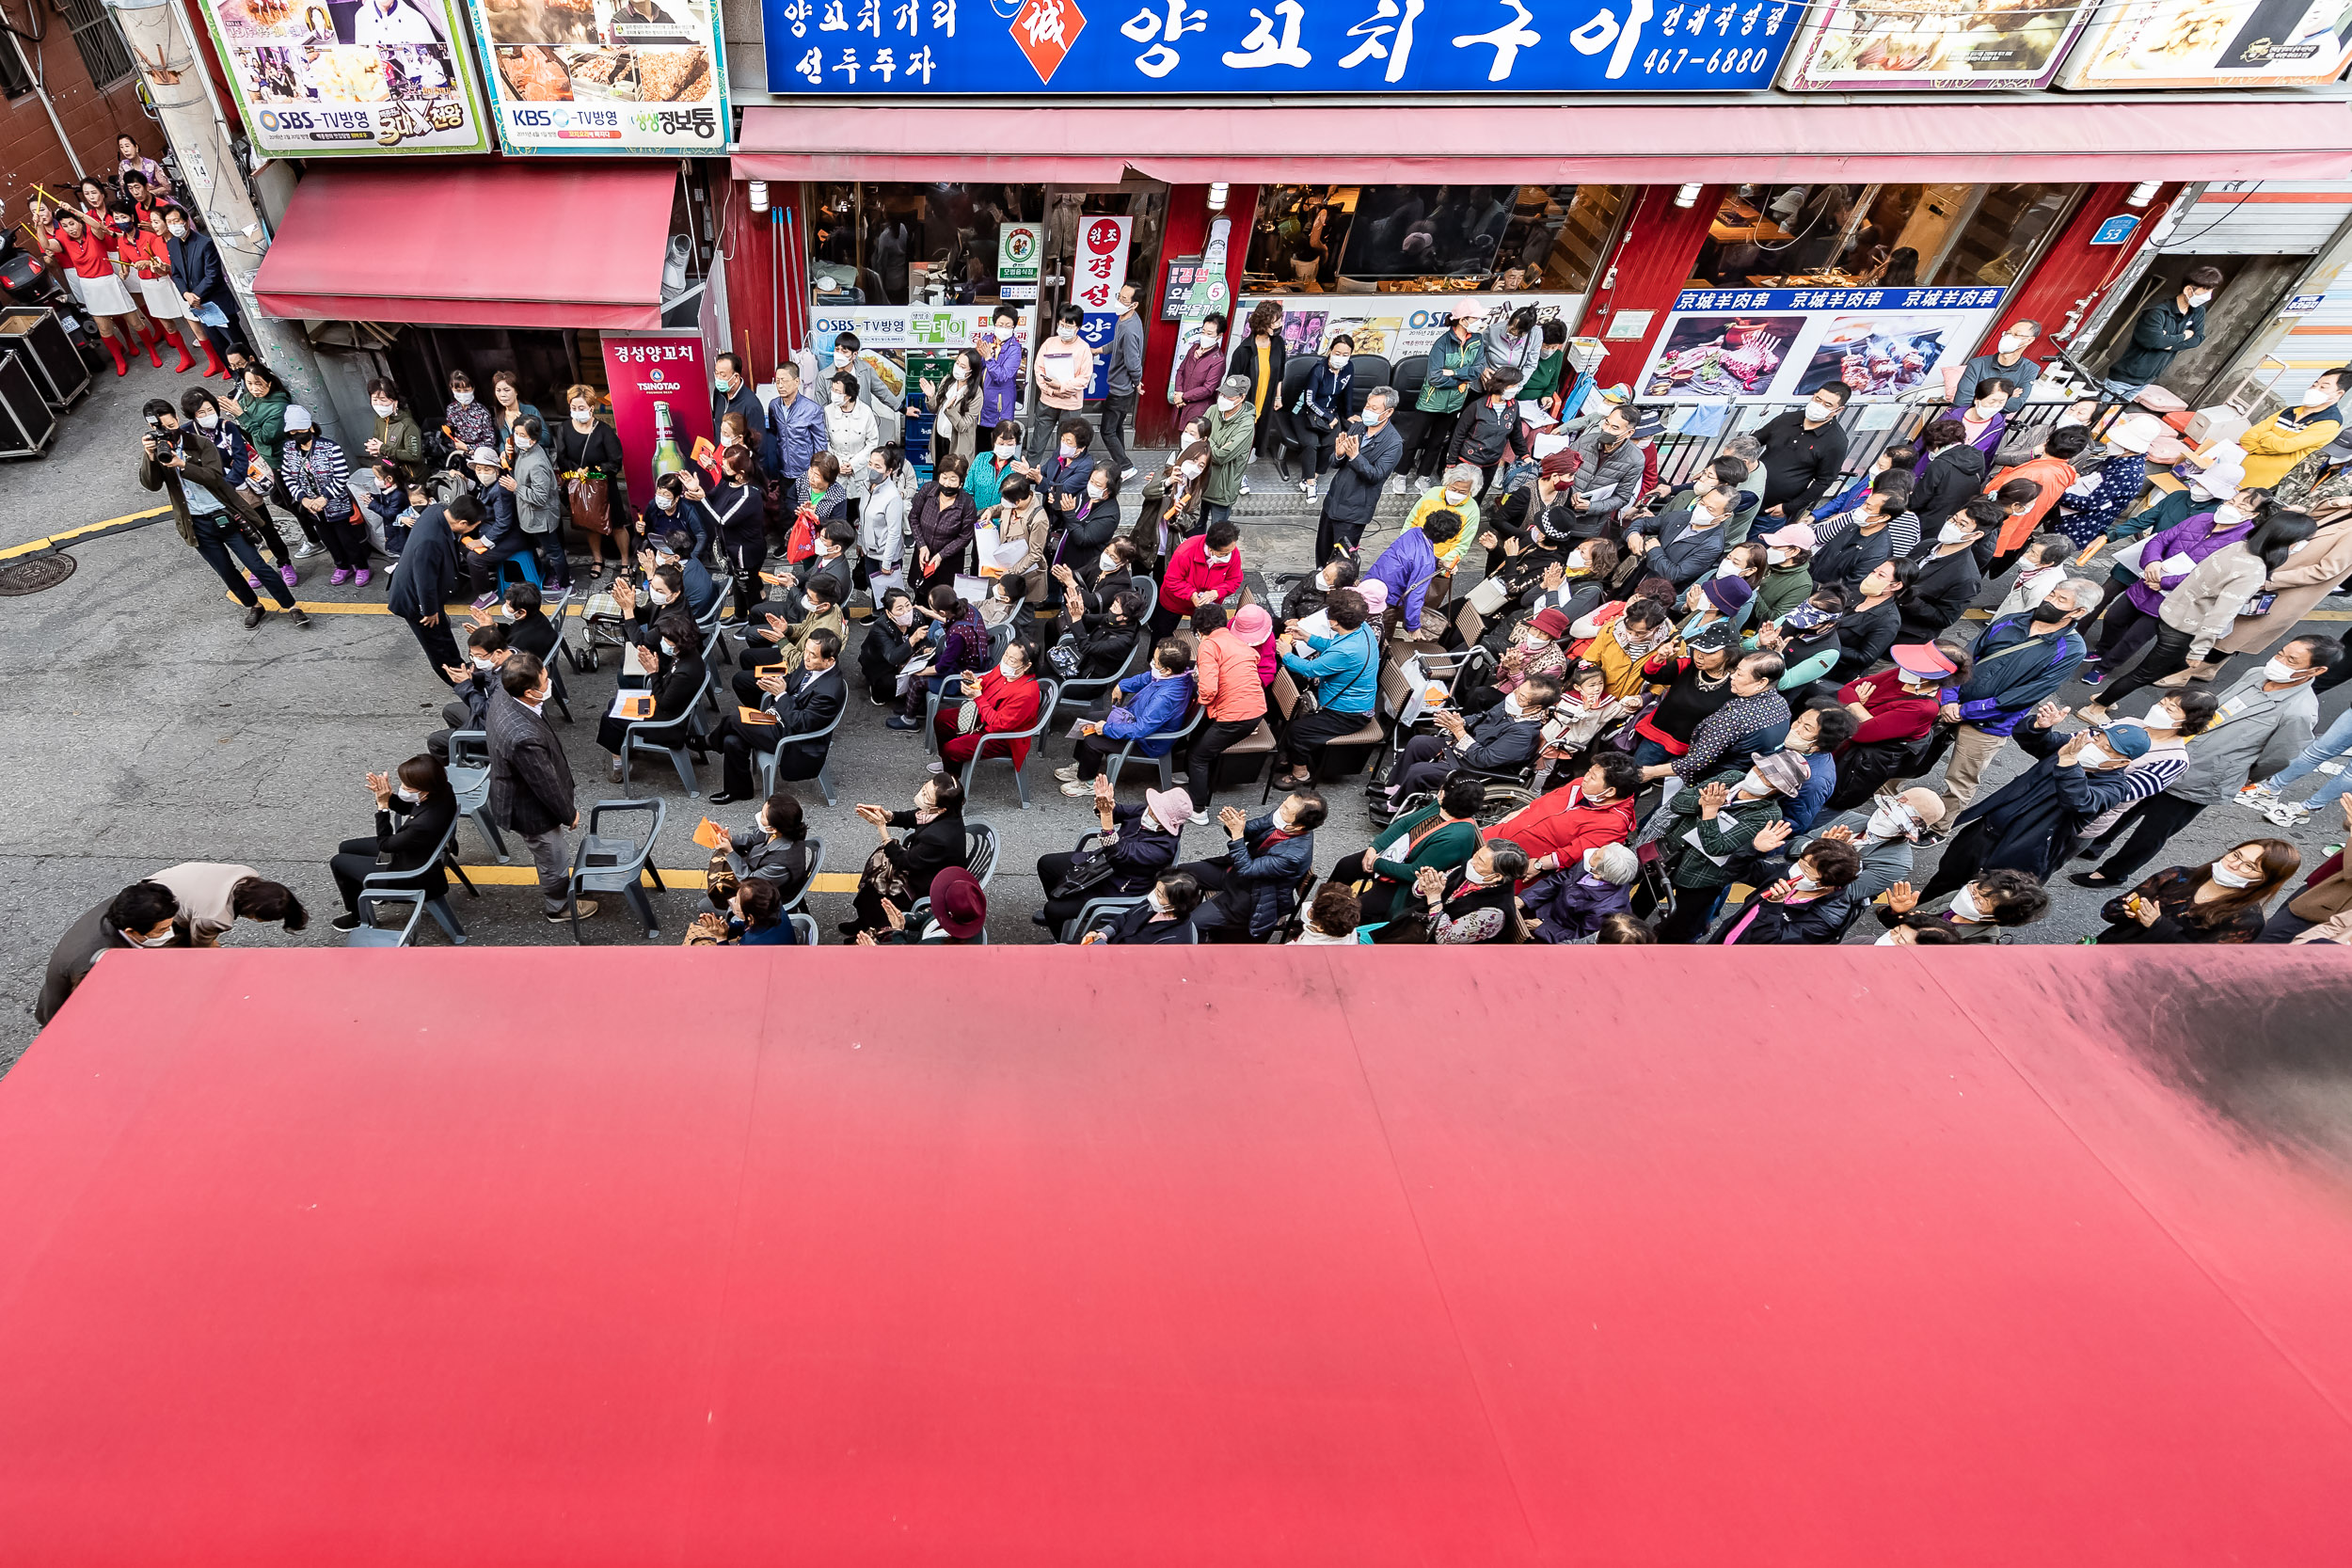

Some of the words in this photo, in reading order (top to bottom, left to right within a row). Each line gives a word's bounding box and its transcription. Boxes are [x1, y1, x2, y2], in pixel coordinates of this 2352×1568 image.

[796, 45, 937, 86] 선두주자
[1644, 48, 1769, 74] 467-6880
[513, 110, 551, 126] KBS
[1089, 228, 1118, 245] 원조
[2102, 229, 2122, 241] 53
[1168, 287, 1194, 300] 오늘
[1677, 292, 1772, 310] 京城羊肉串
[1788, 291, 1884, 309] 京城羊肉串
[1900, 290, 1998, 309] 京城羊肉串
[614, 345, 694, 362] 경성양꼬치
[637, 382, 681, 390] TSINGTAO
